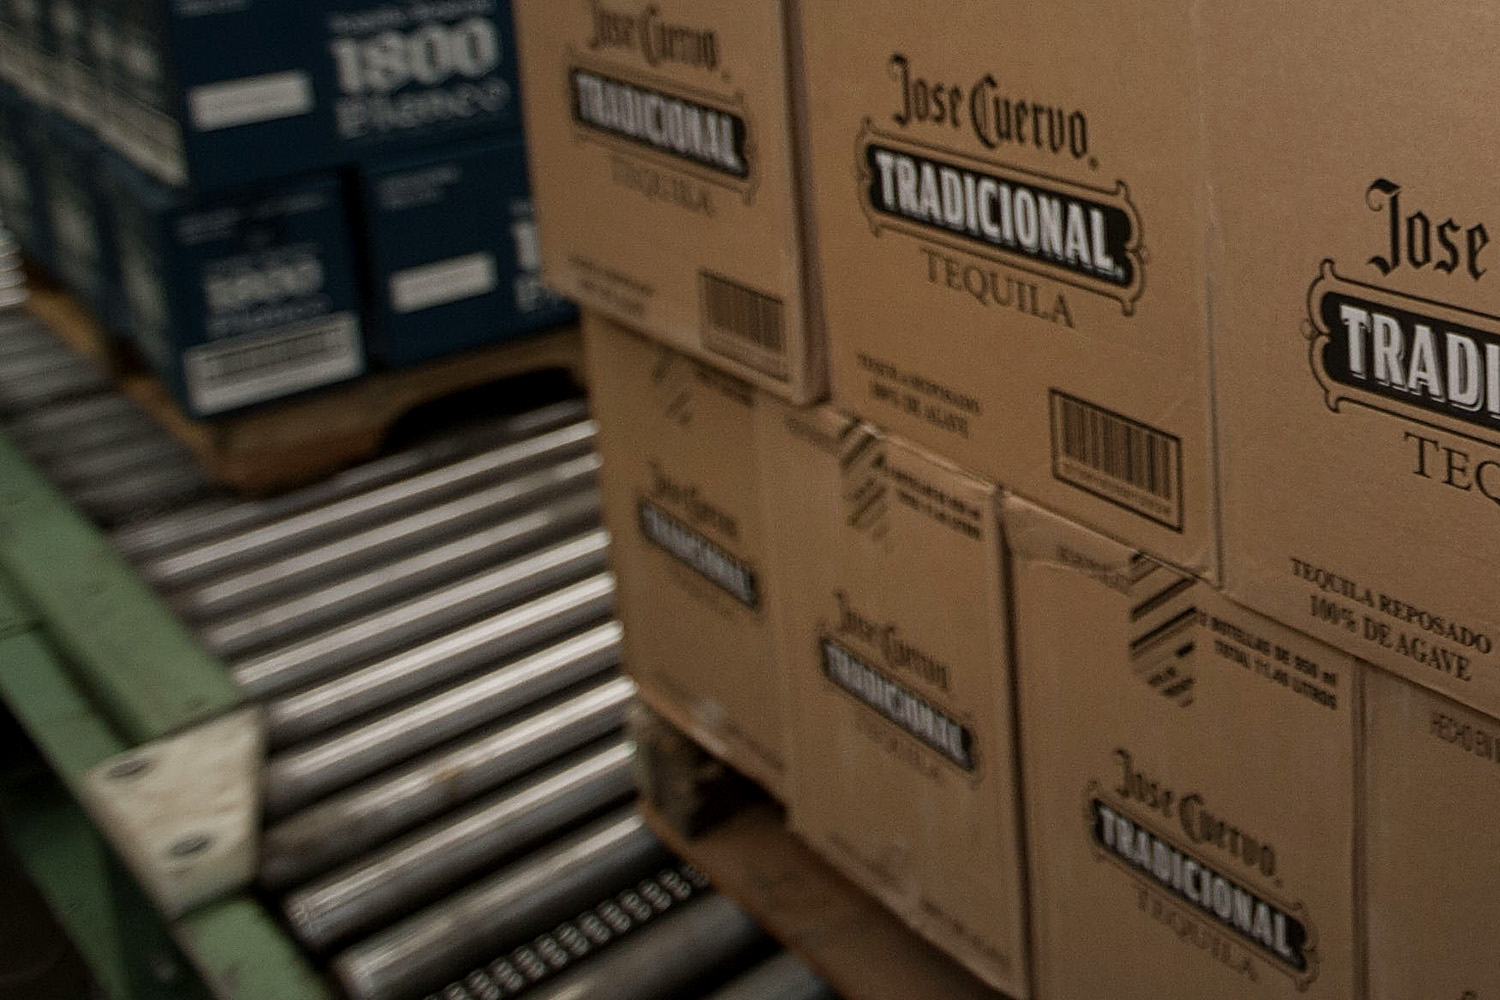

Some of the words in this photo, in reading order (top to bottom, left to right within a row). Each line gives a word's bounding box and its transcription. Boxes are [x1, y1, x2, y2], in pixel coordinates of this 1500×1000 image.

[887, 52, 963, 128] Jose
[968, 72, 1089, 160] Cuervo
[874, 149, 1116, 278] TRADICIONAL
[1365, 177, 1492, 281] Jose
[919, 247, 1076, 330] TEQUILA
[1290, 556, 1375, 609] TEQUILA
[1378, 593, 1493, 655] REPOSADO
[1362, 614, 1394, 649] DE
[1396, 632, 1473, 683] AGAVE
[1101, 806, 1292, 956] TRADICIONAL
